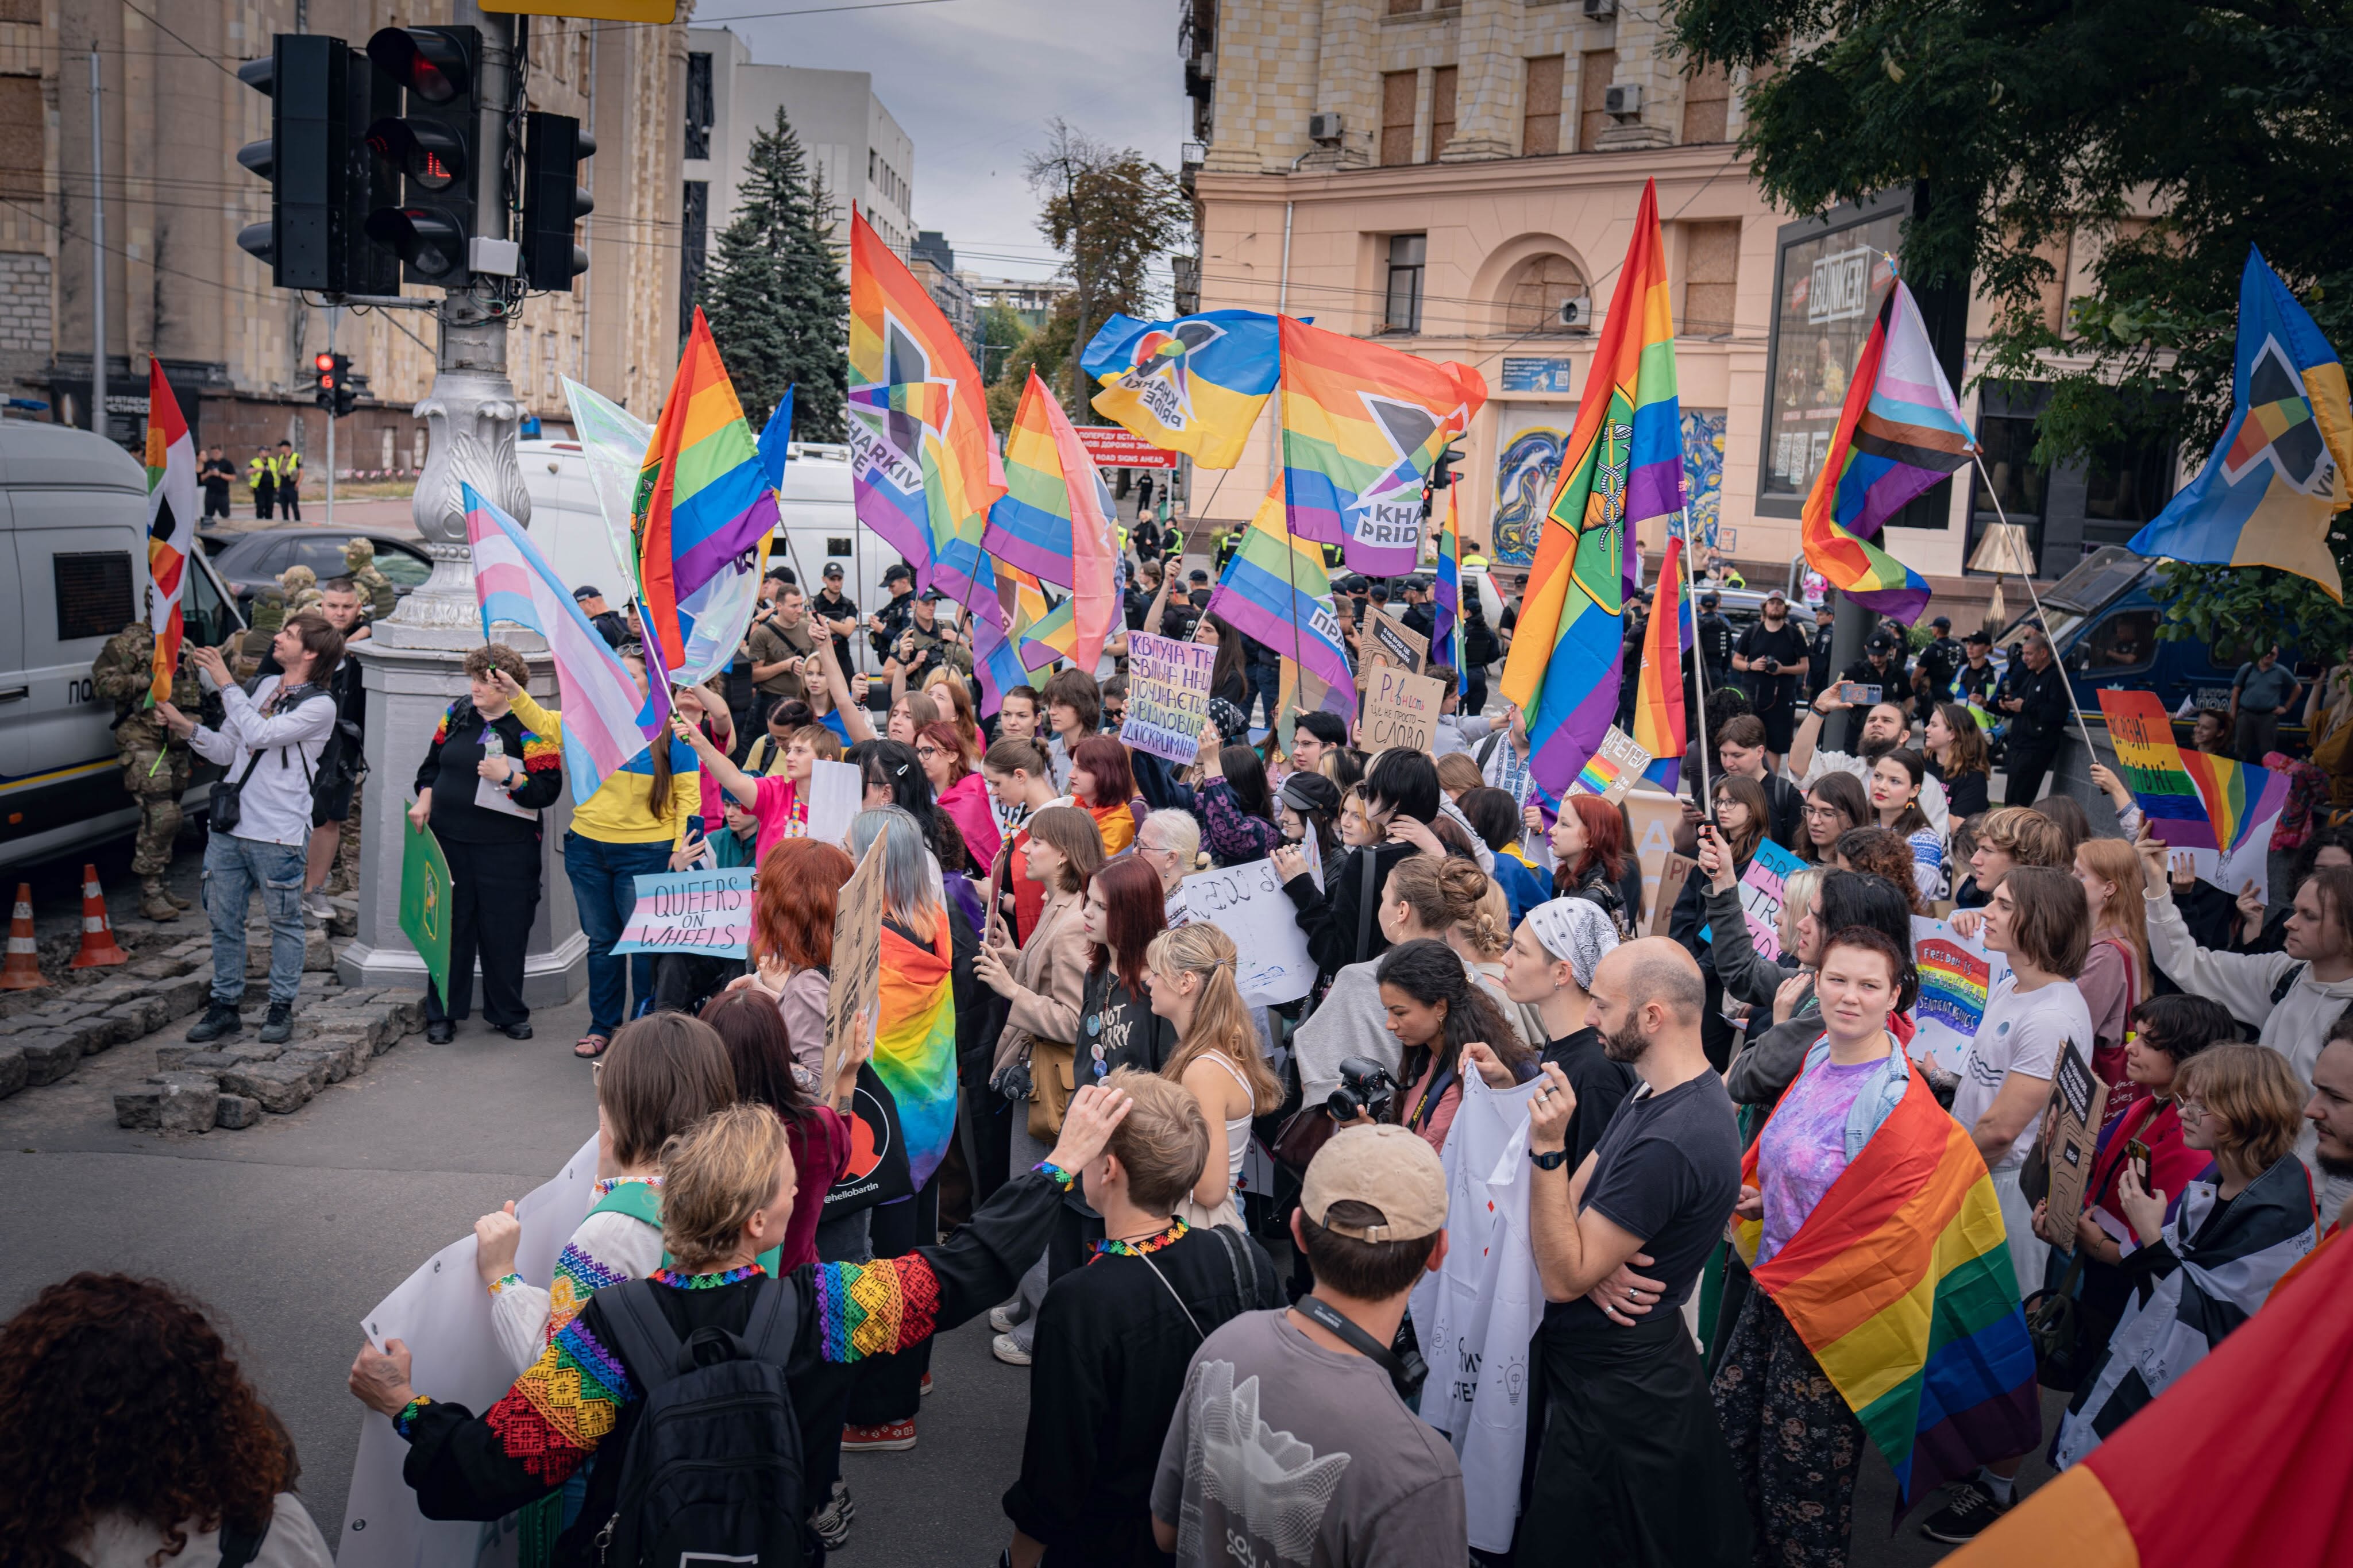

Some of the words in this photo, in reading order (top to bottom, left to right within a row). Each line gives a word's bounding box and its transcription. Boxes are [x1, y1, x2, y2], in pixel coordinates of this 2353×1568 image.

[1811, 258, 1864, 314] BUNKER
[848, 419, 921, 489] HARKIV
[1096, 454, 1116, 462] ROAD
[1117, 454, 1139, 462] SIGNS
[1140, 455, 1164, 464] AHEAD
[1361, 520, 1418, 543] PRID
[1131, 634, 1185, 665] КВІТУЧА
[1140, 658, 1178, 685] ВІЛЬНА
[69, 678, 92, 704] ПО
[654, 876, 741, 917] QUEERS
[682, 913, 705, 929] ON
[641, 923, 735, 949] WHEELS
[1924, 948, 1961, 968] FREEDOM
[1963, 961, 1972, 976] IS
[1922, 970, 1937, 983] THE
[1939, 974, 1964, 990] RIGHT
[1964, 982, 1974, 995] OF
